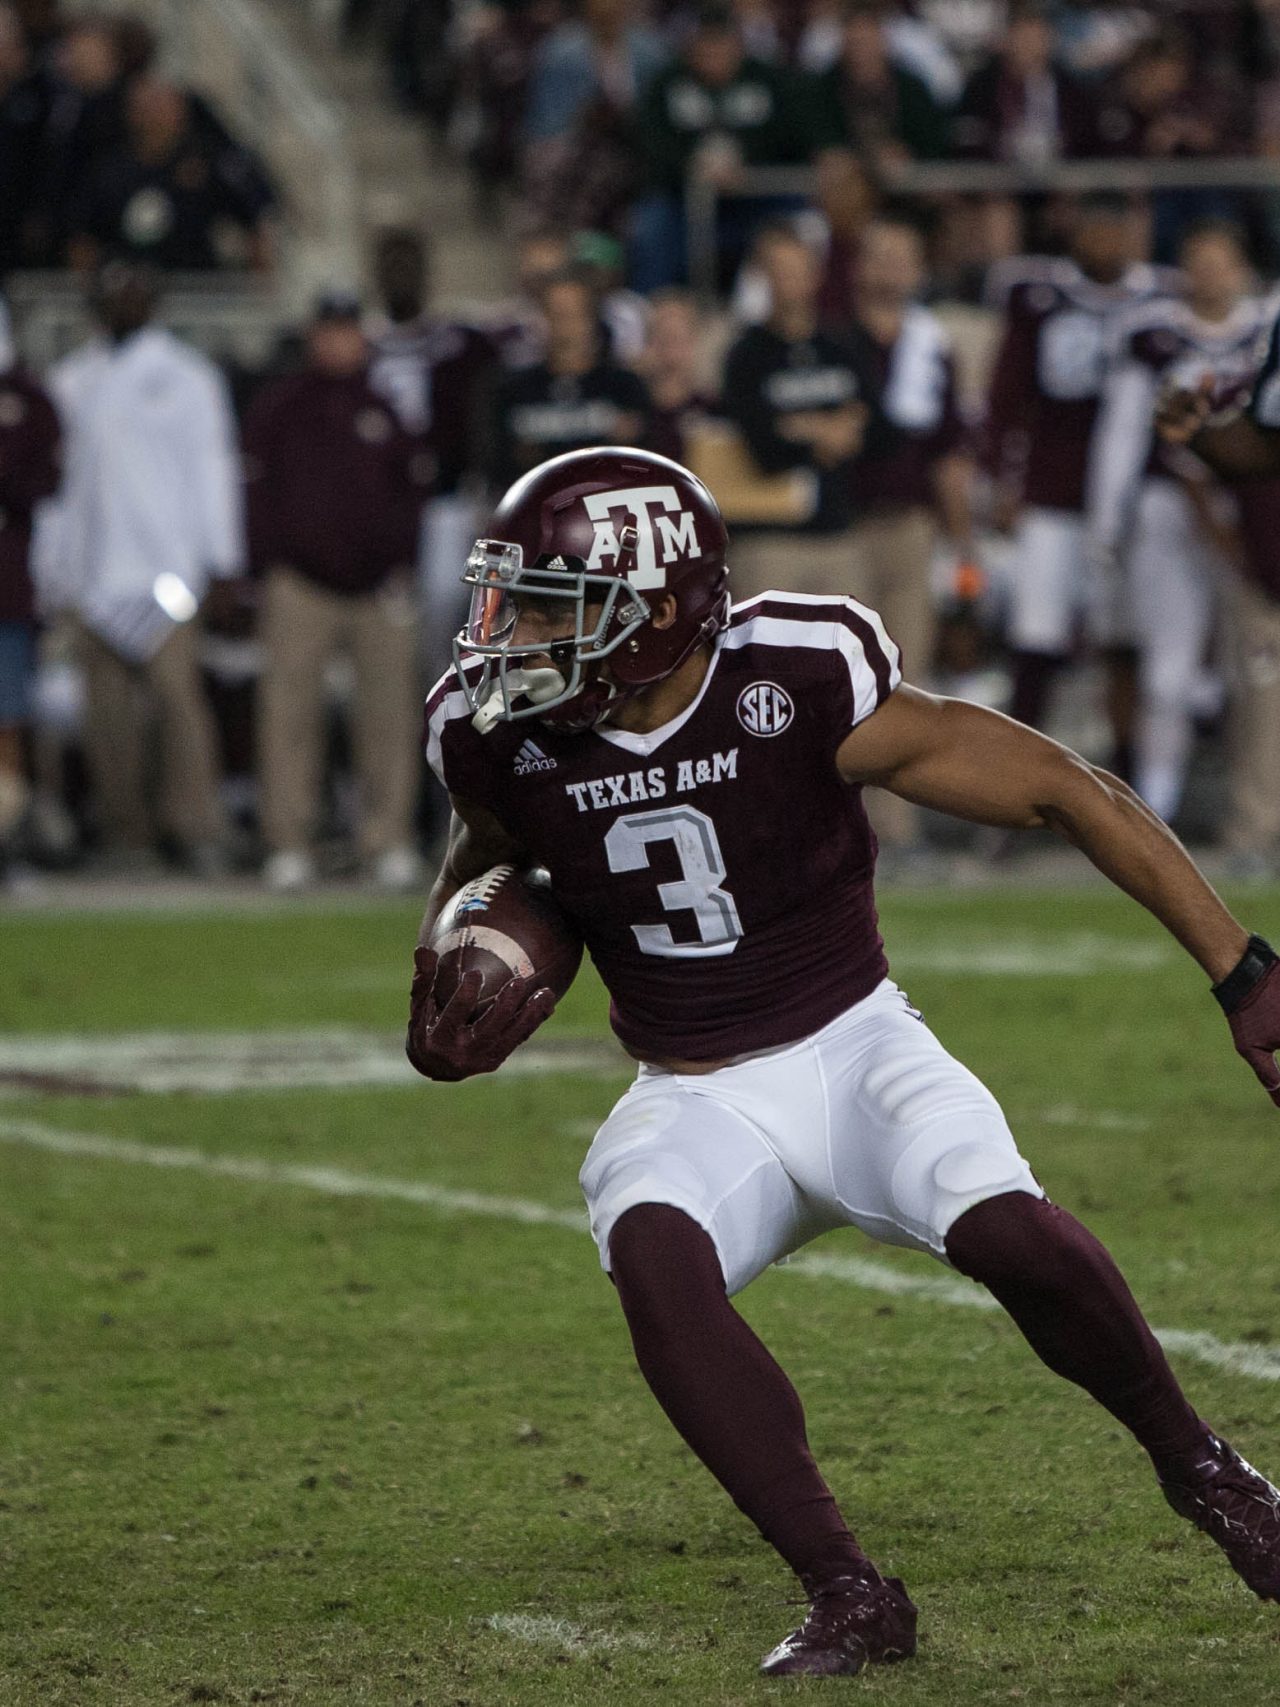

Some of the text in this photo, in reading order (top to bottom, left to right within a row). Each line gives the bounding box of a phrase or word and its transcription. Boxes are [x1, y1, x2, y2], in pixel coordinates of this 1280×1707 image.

[742, 686, 788, 732] SEC
[513, 758, 558, 776] adidas
[565, 748, 740, 812] TEXAS A&M
[603, 803, 745, 958] 3
